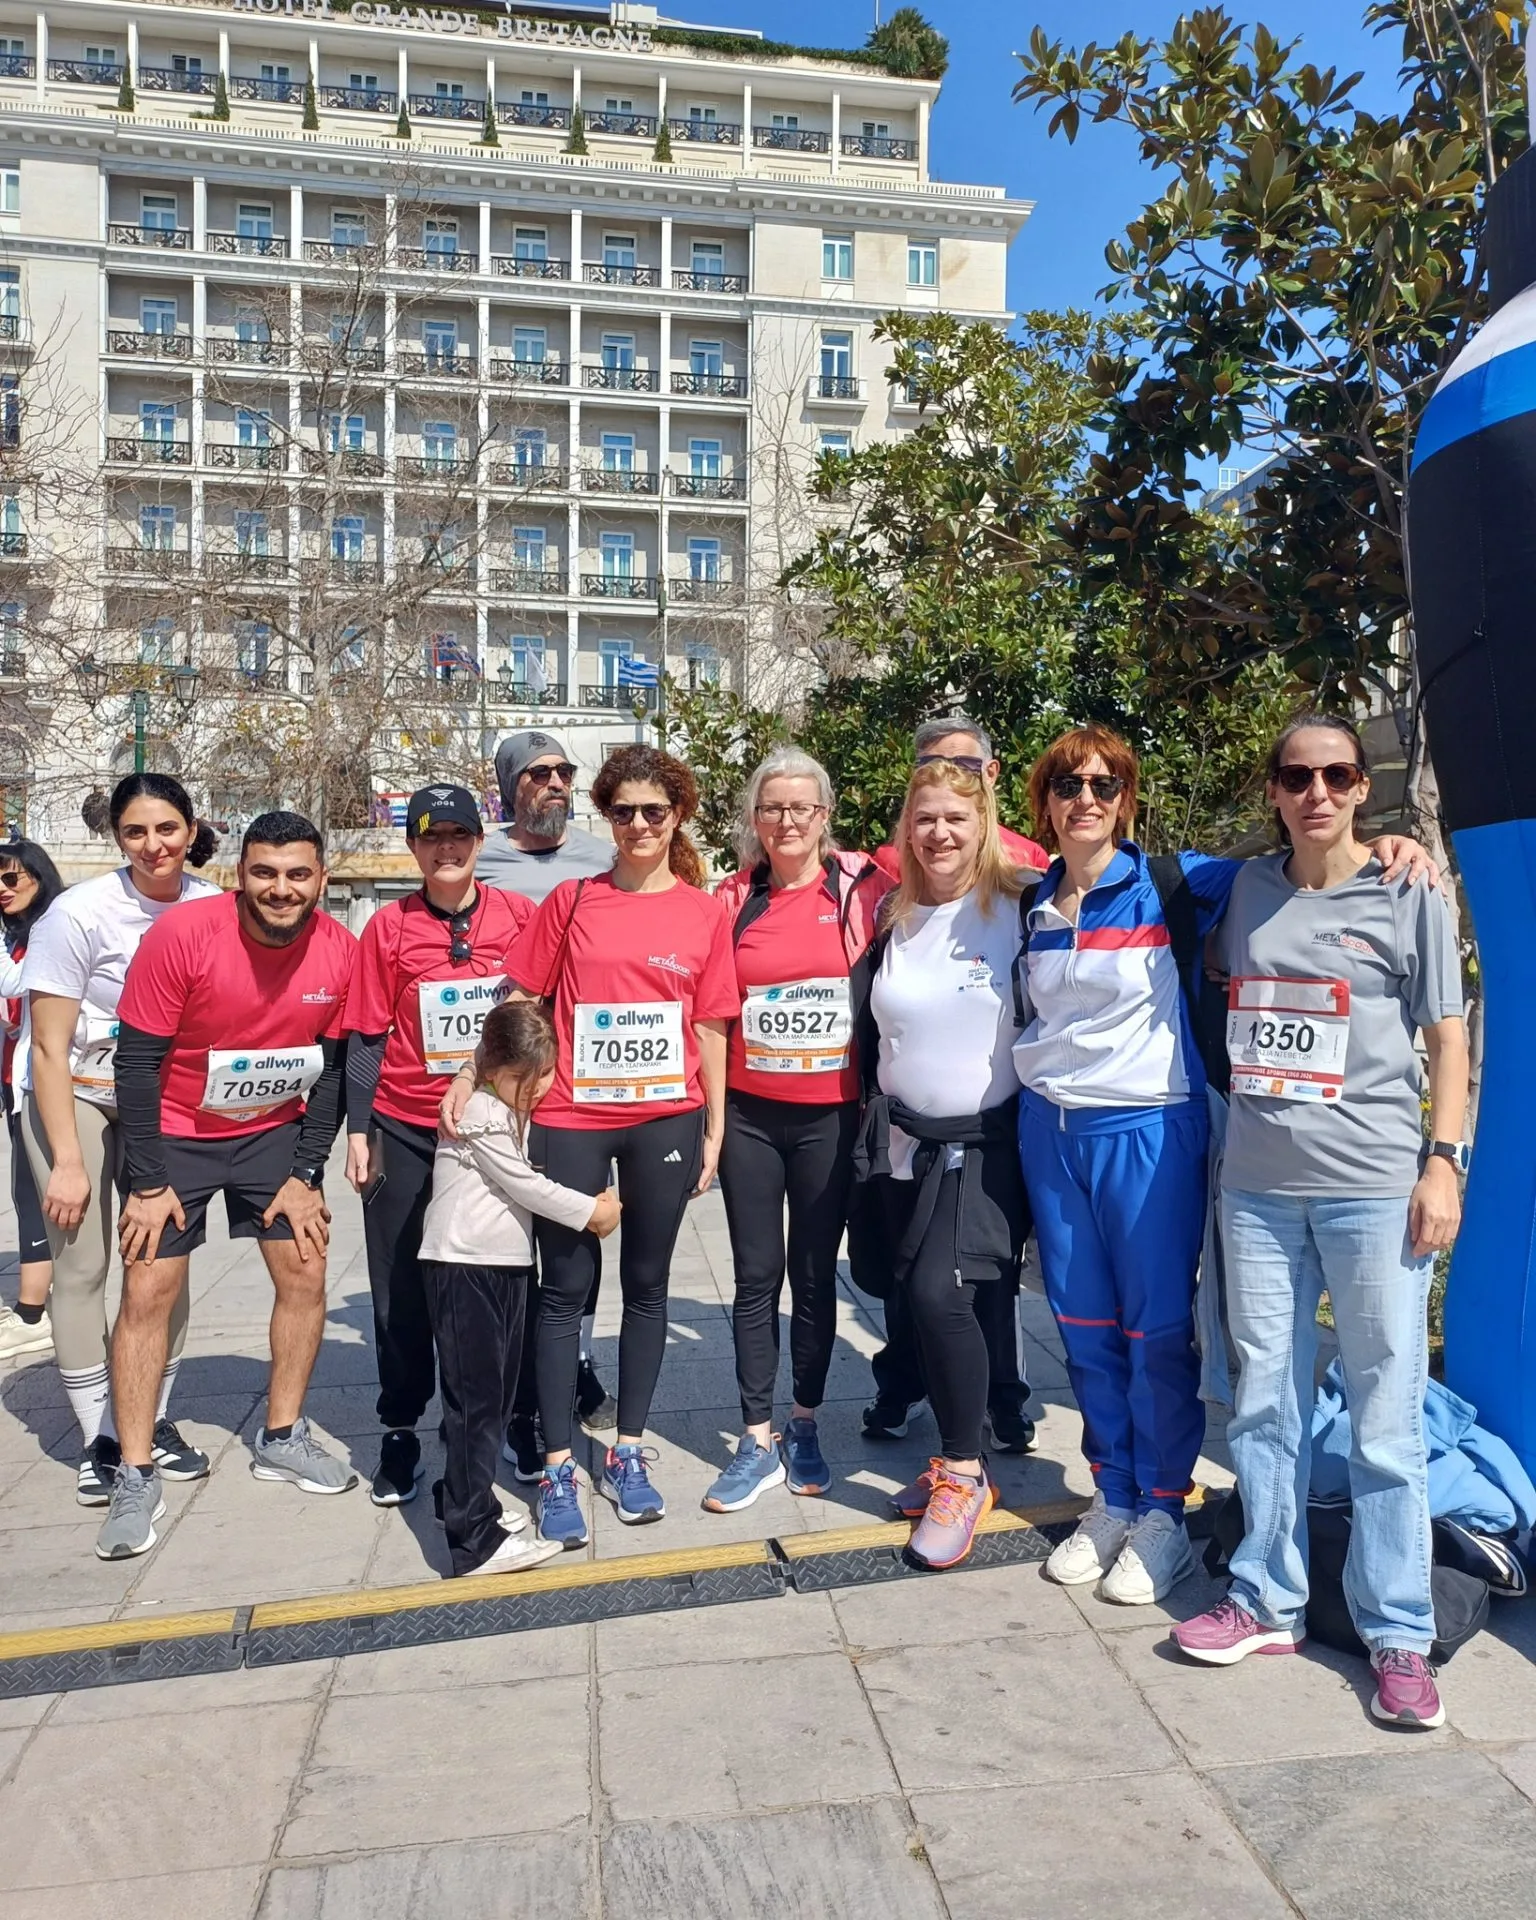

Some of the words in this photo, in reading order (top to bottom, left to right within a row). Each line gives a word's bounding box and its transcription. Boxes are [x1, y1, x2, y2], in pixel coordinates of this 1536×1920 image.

[351, 2, 479, 36] GRANDE
[496, 16, 653, 52] BRETAGNE
[463, 985, 510, 1001] allwyn
[785, 986, 834, 1001] allwyn
[438, 1013, 486, 1037] 705
[616, 1010, 664, 1029] allwyn
[758, 1011, 838, 1034] 69527
[1248, 1021, 1315, 1053] 1350
[591, 1038, 669, 1063] 70582
[255, 1056, 305, 1071] allwyn
[223, 1078, 303, 1099] 70584
